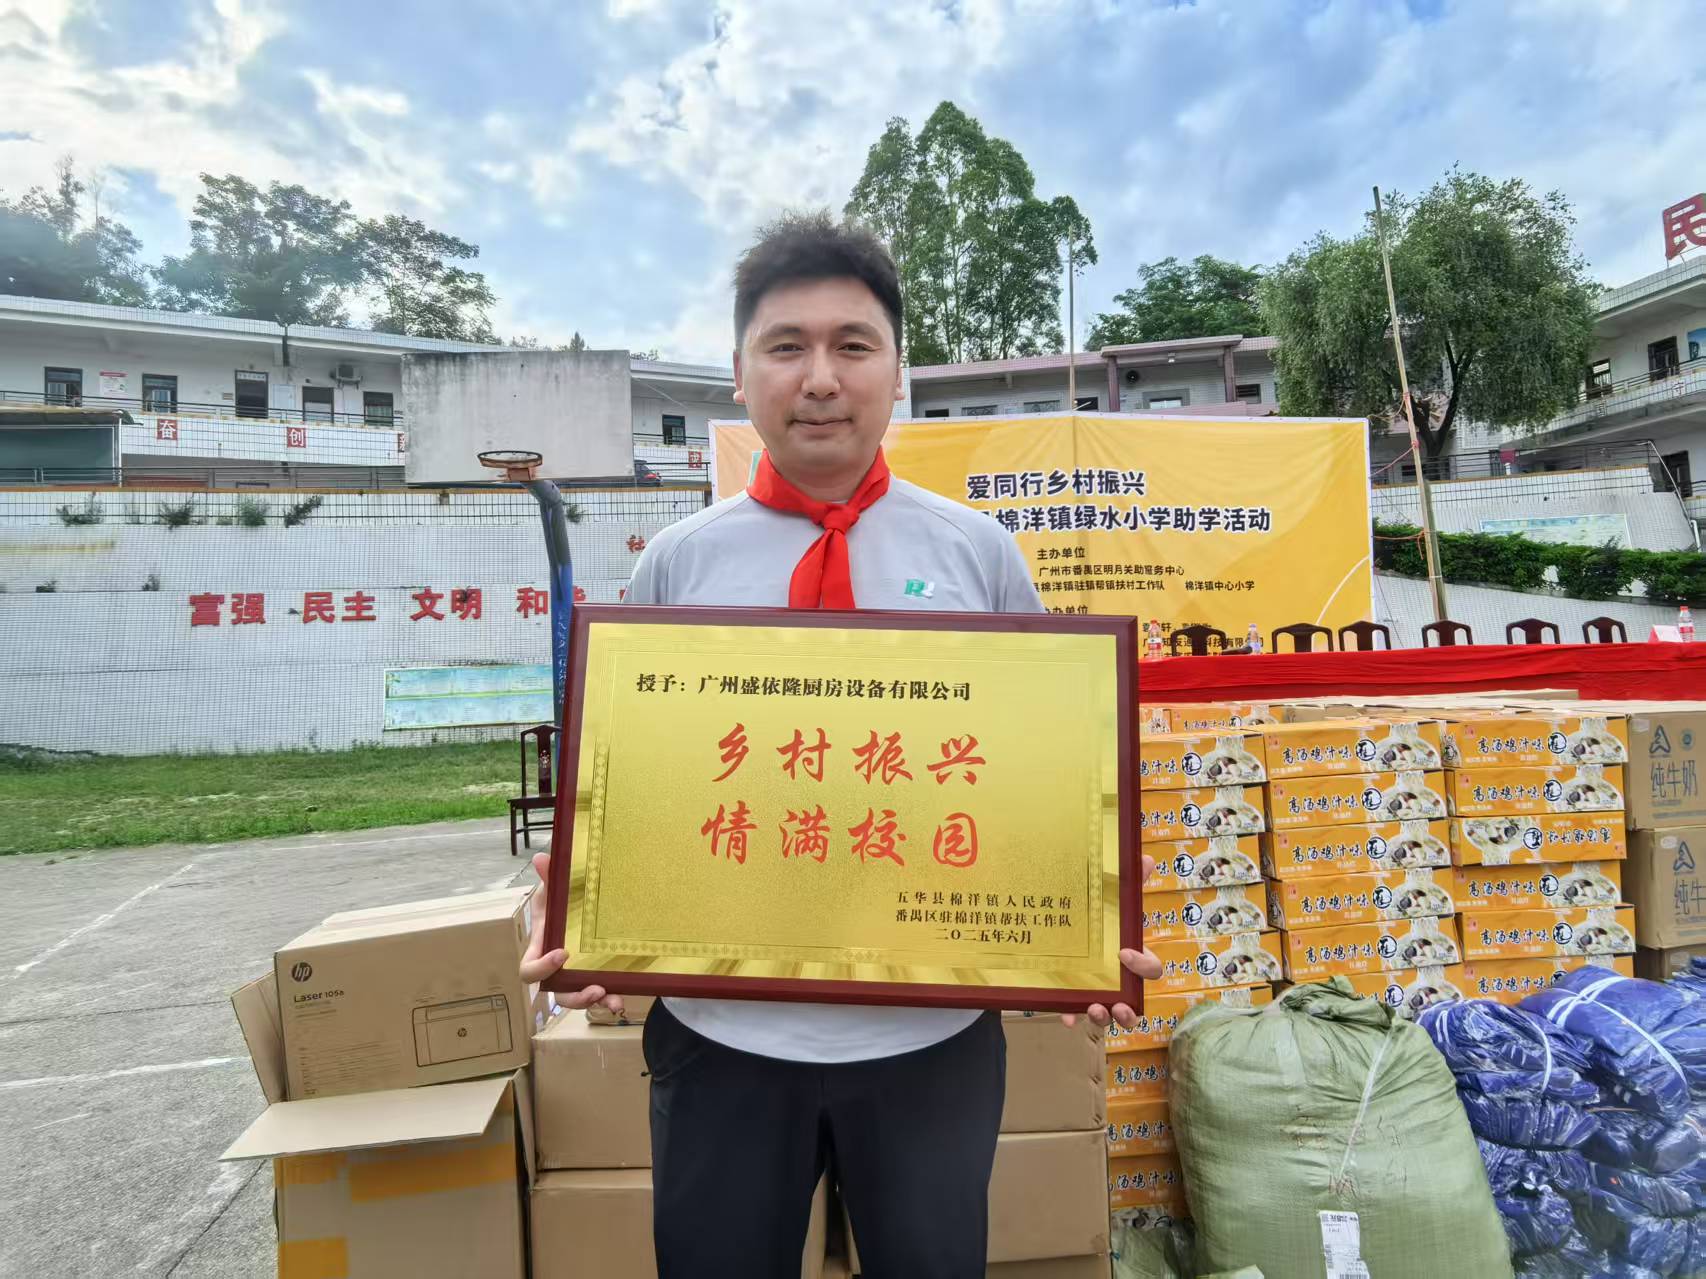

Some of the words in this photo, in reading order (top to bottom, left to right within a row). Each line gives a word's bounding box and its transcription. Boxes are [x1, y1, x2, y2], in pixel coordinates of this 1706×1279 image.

[159, 421, 178, 440] 奋
[288, 428, 306, 447] 创
[967, 469, 1145, 500] 爱同行乡村振兴
[982, 505, 1271, 533] 棉洋镇绿水小学助学活动
[1037, 547, 1085, 560] 主办单位
[1185, 580, 1255, 591] 棉洋镇中心小学
[190, 592, 266, 627] 富强
[302, 591, 377, 623] 民主
[410, 587, 482, 620] 文明
[711, 722, 986, 786] 乡村振兴
[1651, 760, 1698, 799] 纯牛奶
[700, 800, 979, 868] 情满校园
[896, 891, 1072, 910] 五华县棉洋镇人民政府
[896, 909, 1072, 928] 番禺区驻棉洋镇帮扶工作队
[291, 962, 312, 982] hp
[294, 992, 322, 1002] Laser
